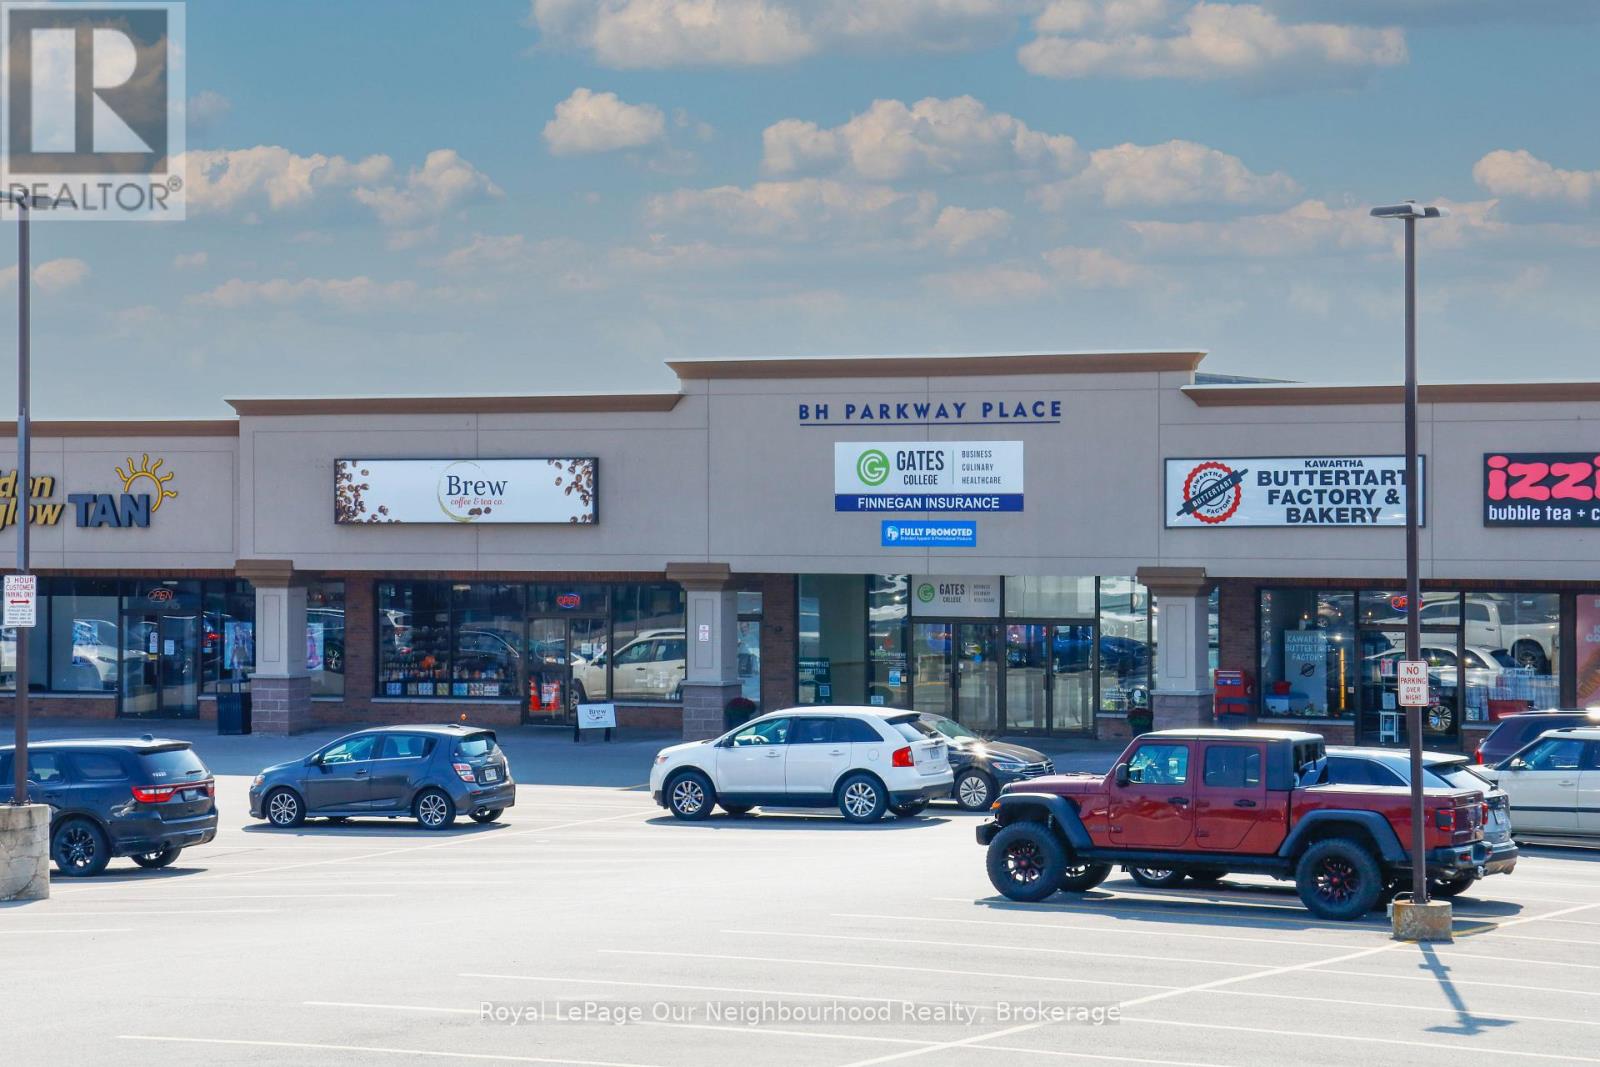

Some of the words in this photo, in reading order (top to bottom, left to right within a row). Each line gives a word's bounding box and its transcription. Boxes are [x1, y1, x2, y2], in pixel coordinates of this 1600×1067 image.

[799, 404, 828, 420] BH
[845, 402, 966, 420] PARKWAY
[982, 401, 1061, 418] PLACE
[961, 450, 992, 458] BUSINESS
[896, 450, 944, 471] GATES
[1304, 460, 1363, 468] KAWARTHA
[961, 463, 993, 471] CULINARY
[903, 474, 938, 485] COLLEGE
[961, 476, 1001, 485] HEALTHCARE
[1192, 471, 1223, 495] KAWARTHA
[1257, 469, 1407, 486] BUTTERTART
[446, 475, 508, 496] Brew
[1192, 478, 1233, 507] BUTTERTART
[1268, 489, 1377, 505] FACTORY
[1385, 488, 1400, 505] &
[451, 497, 471, 508] coffee
[473, 497, 479, 505] &
[858, 497, 922, 509] FINNEGAN
[925, 497, 1000, 509] INSURANCE
[1206, 494, 1232, 514] FACTORY
[68, 494, 150, 528] TAN
[1286, 507, 1382, 524] BAKERY
[1489, 505, 1541, 520] bubble
[1546, 505, 1571, 520] tea
[900, 527, 924, 536] FULLY
[926, 527, 973, 536] PROMOTED
[148, 591, 173, 600] OPEN
[940, 584, 965, 595] GATES
[557, 594, 580, 606] OPEN
[1406, 666, 1419, 675] NO
